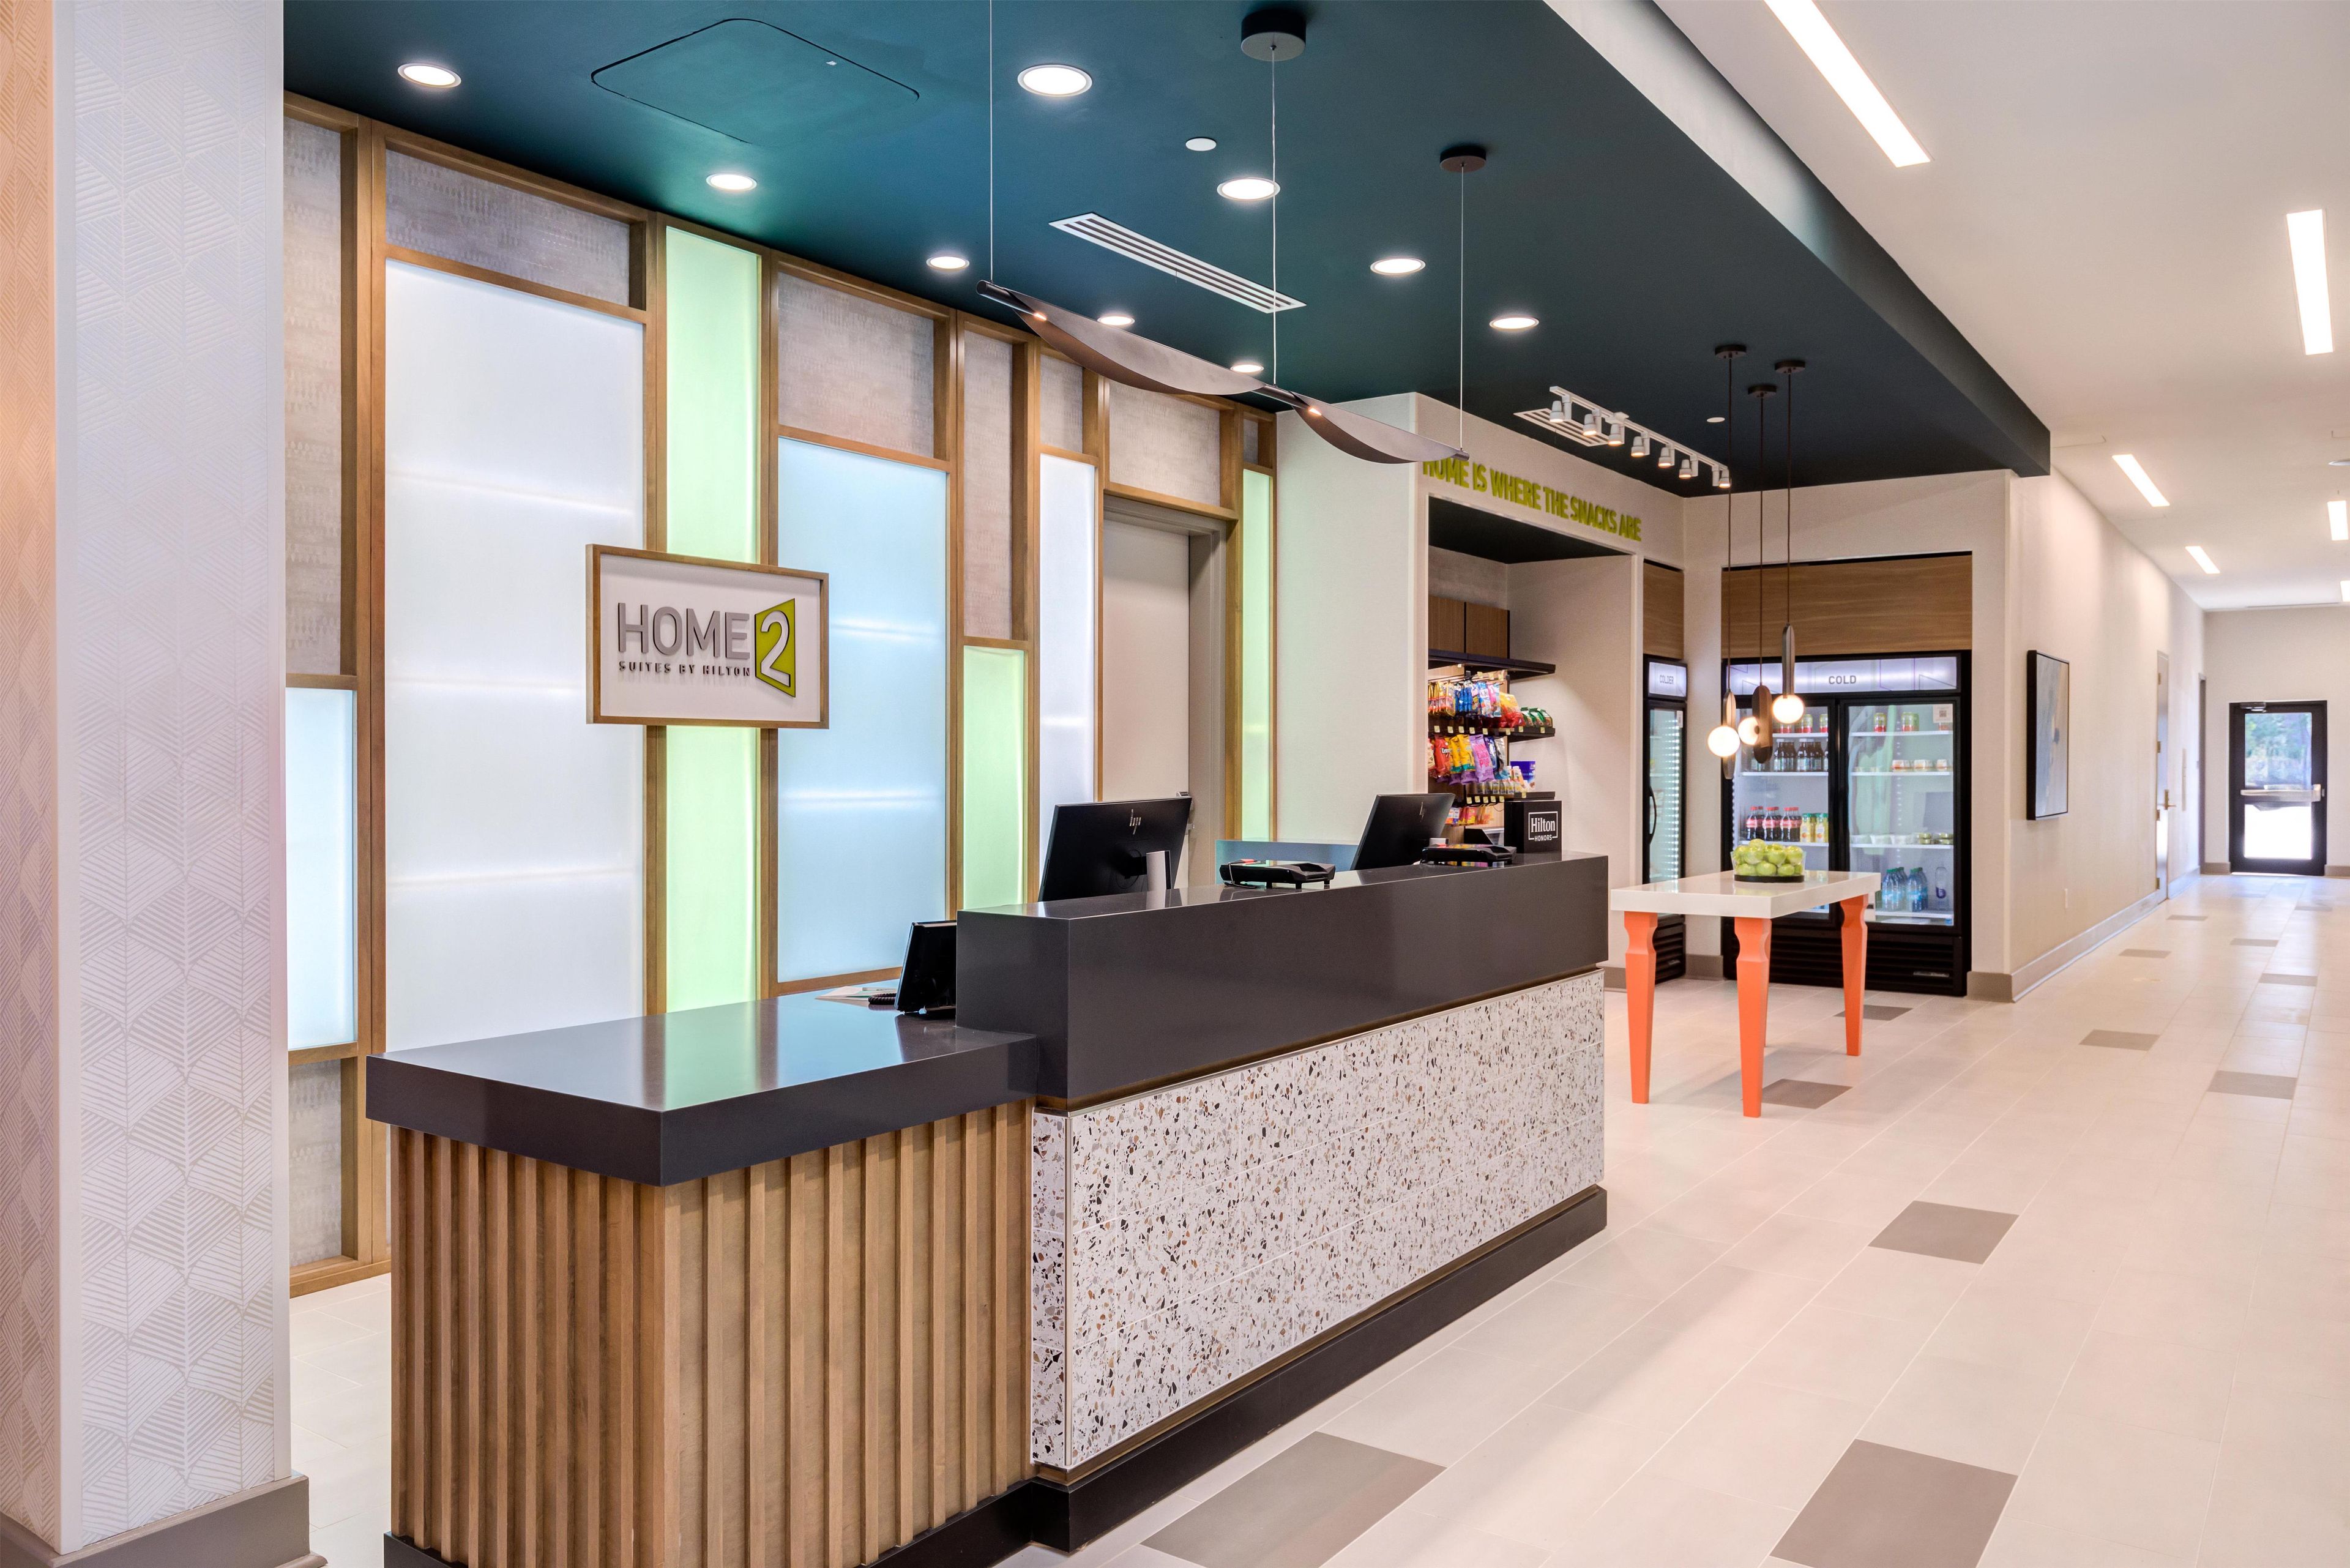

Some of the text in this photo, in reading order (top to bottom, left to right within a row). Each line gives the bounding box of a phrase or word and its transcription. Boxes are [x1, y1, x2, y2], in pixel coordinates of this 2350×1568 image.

[1473, 462, 1487, 492] IS
[1490, 468, 1542, 510] WHERE
[1543, 487, 1569, 519] THE
[1570, 496, 1617, 534] SNACKS
[1619, 514, 1642, 542] ARE
[619, 661, 750, 677] SUITES BY HILTON
[1829, 675, 1857, 684] COLD
[1531, 817, 1556, 832] Hilton
